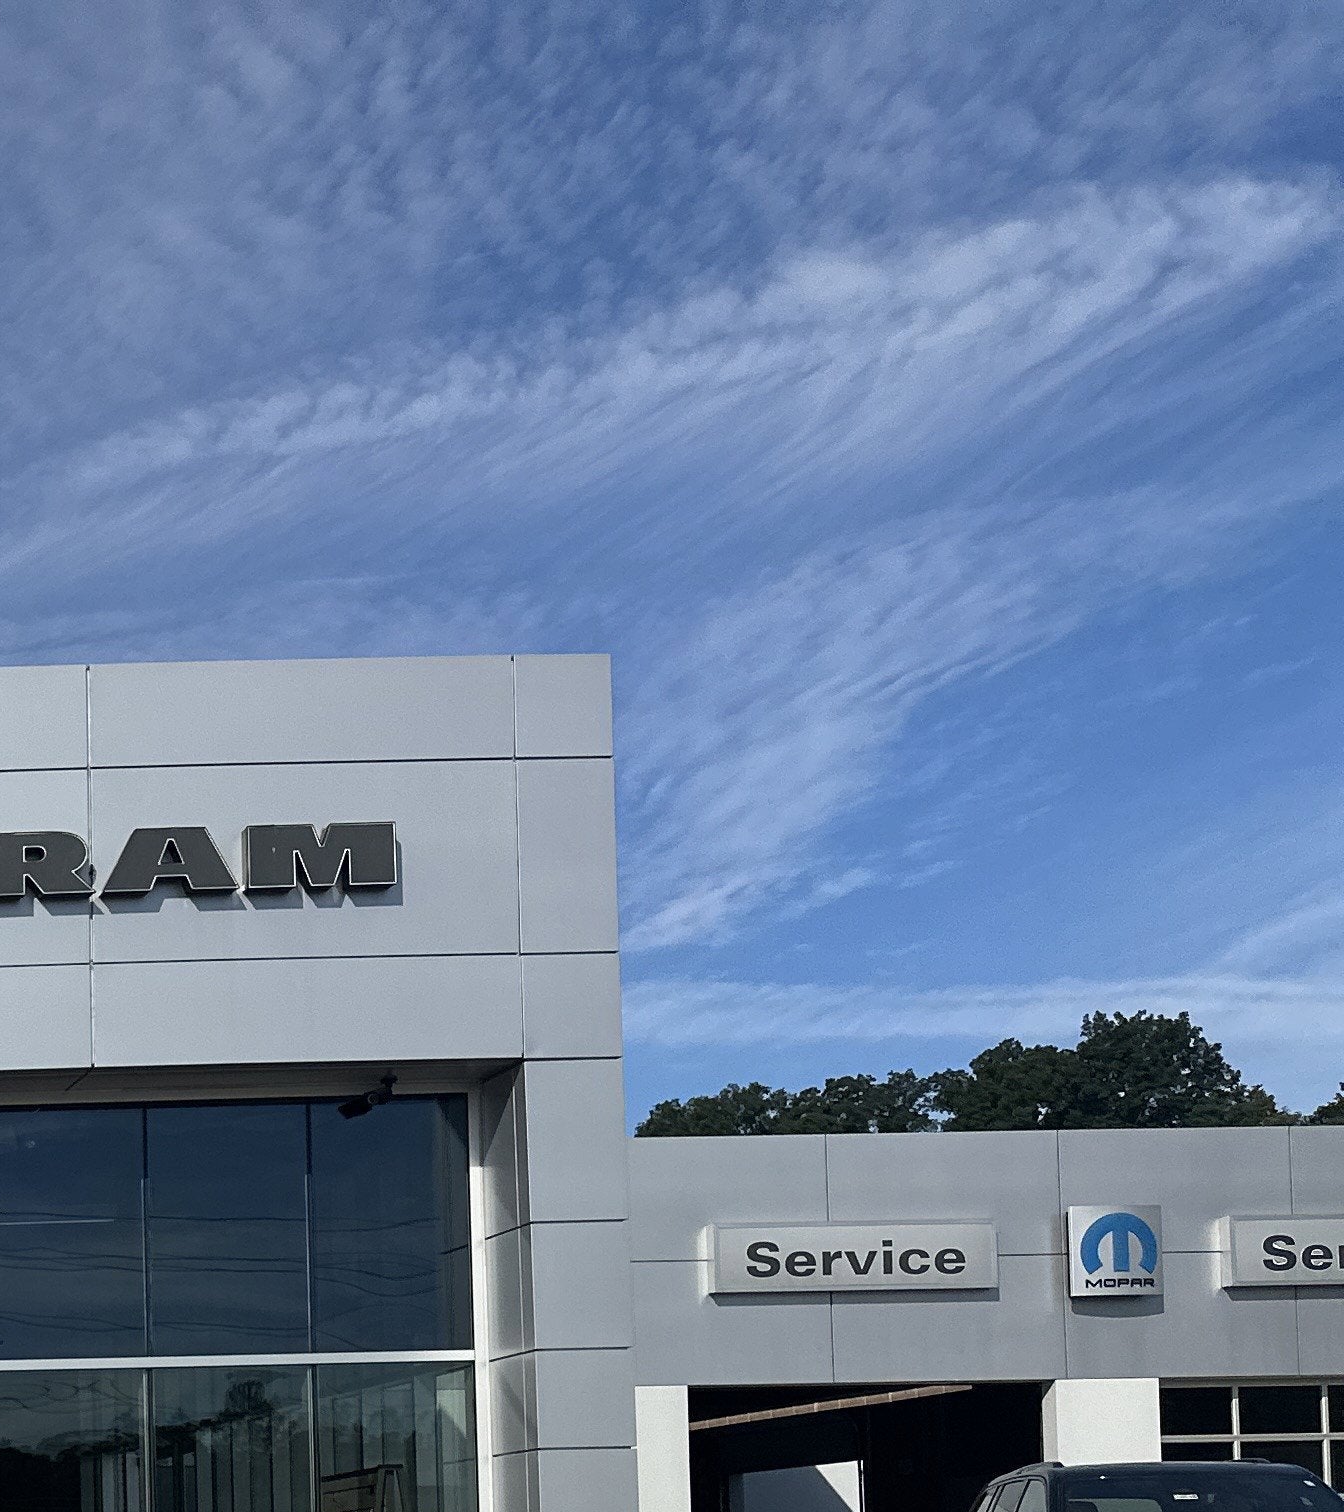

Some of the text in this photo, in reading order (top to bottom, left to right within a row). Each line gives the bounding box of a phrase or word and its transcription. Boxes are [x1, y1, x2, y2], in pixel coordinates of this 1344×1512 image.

[745, 1240, 967, 1278] Service
[1263, 1235, 1344, 1272] Se
[1085, 1277, 1156, 1289] MOPAR
